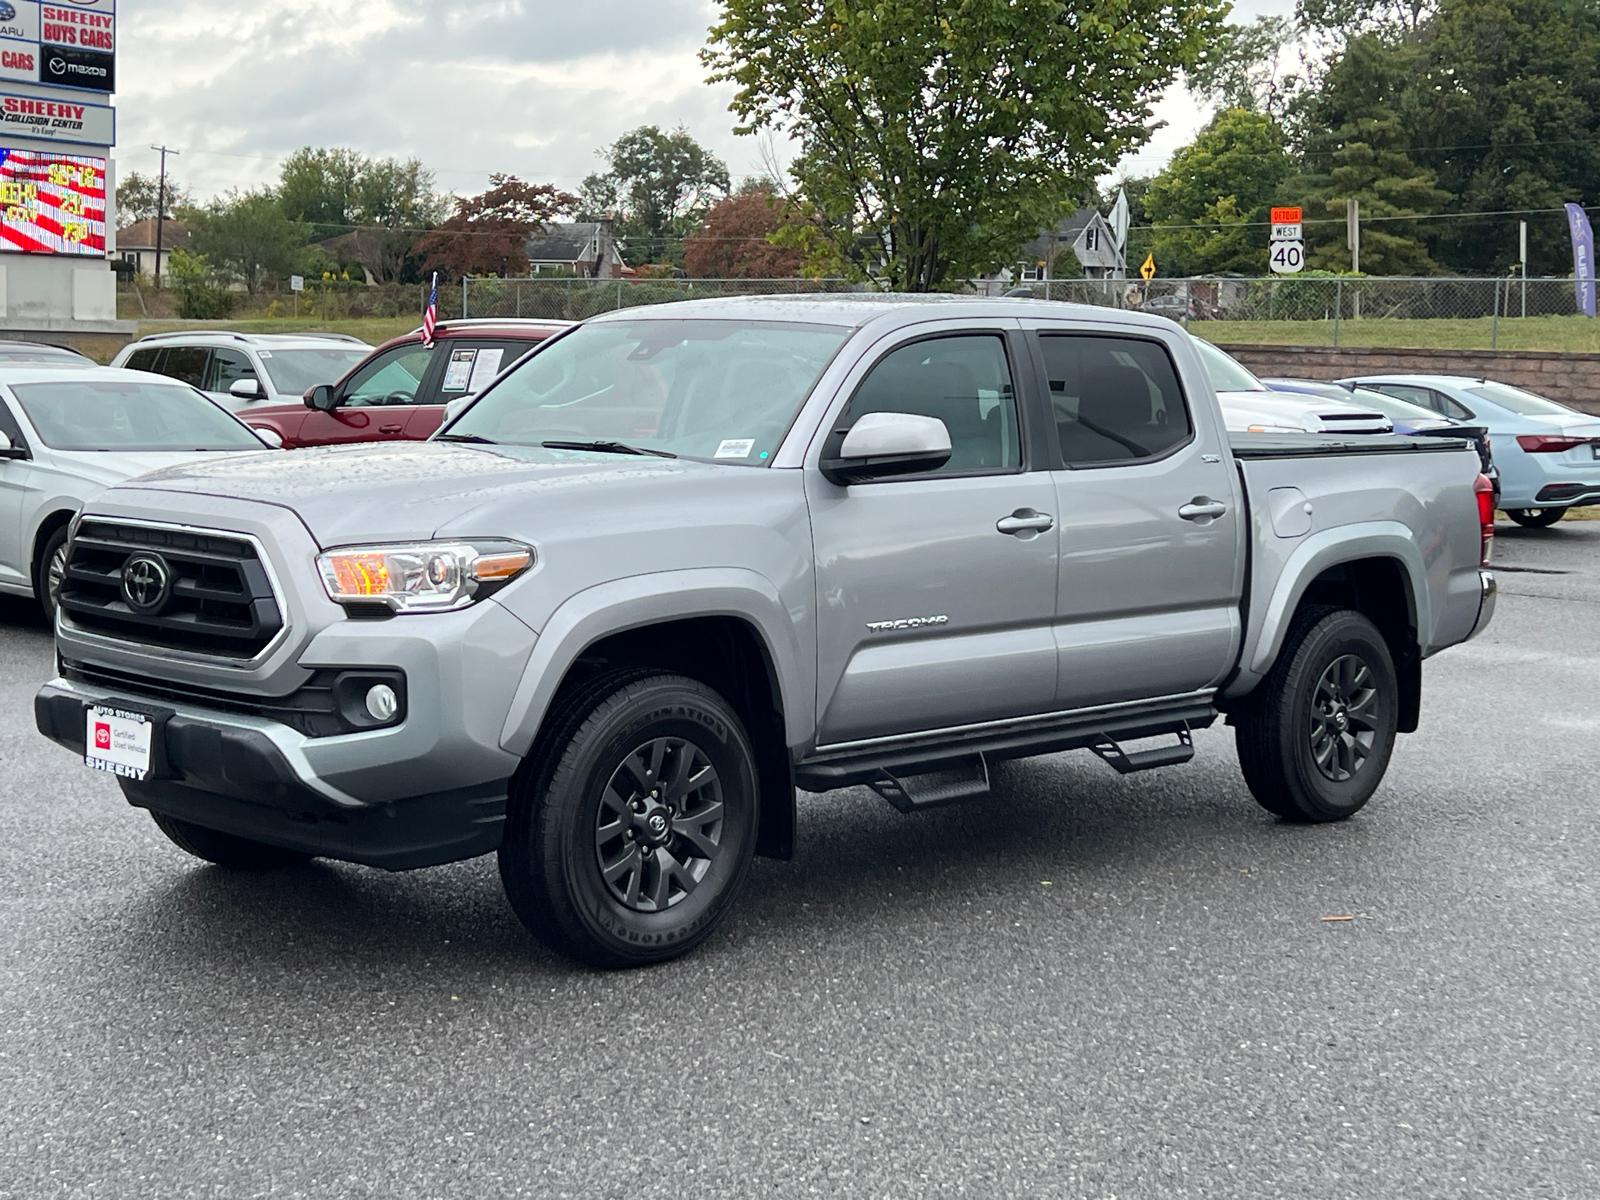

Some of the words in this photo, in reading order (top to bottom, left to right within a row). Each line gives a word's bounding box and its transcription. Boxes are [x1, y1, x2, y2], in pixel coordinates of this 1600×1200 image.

[43, 7, 112, 29] SHEEHY
[43, 22, 77, 44] BUYS
[80, 28, 113, 50] CARS
[2, 50, 35, 72] CARS
[4, 97, 85, 120] SHEEHY
[5, 113, 51, 127] COLLISION
[51, 118, 84, 130] CENTER
[1274, 210, 1299, 220] DETOUR
[1275, 226, 1298, 237] WEST
[1273, 247, 1300, 266] 40
[865, 614, 949, 633] TACOMA
[93, 705, 114, 716] AUTO
[115, 709, 146, 722] STORES
[113, 729, 136, 741] Certified
[113, 741, 127, 750] Used
[85, 756, 147, 781] SHEEHY
